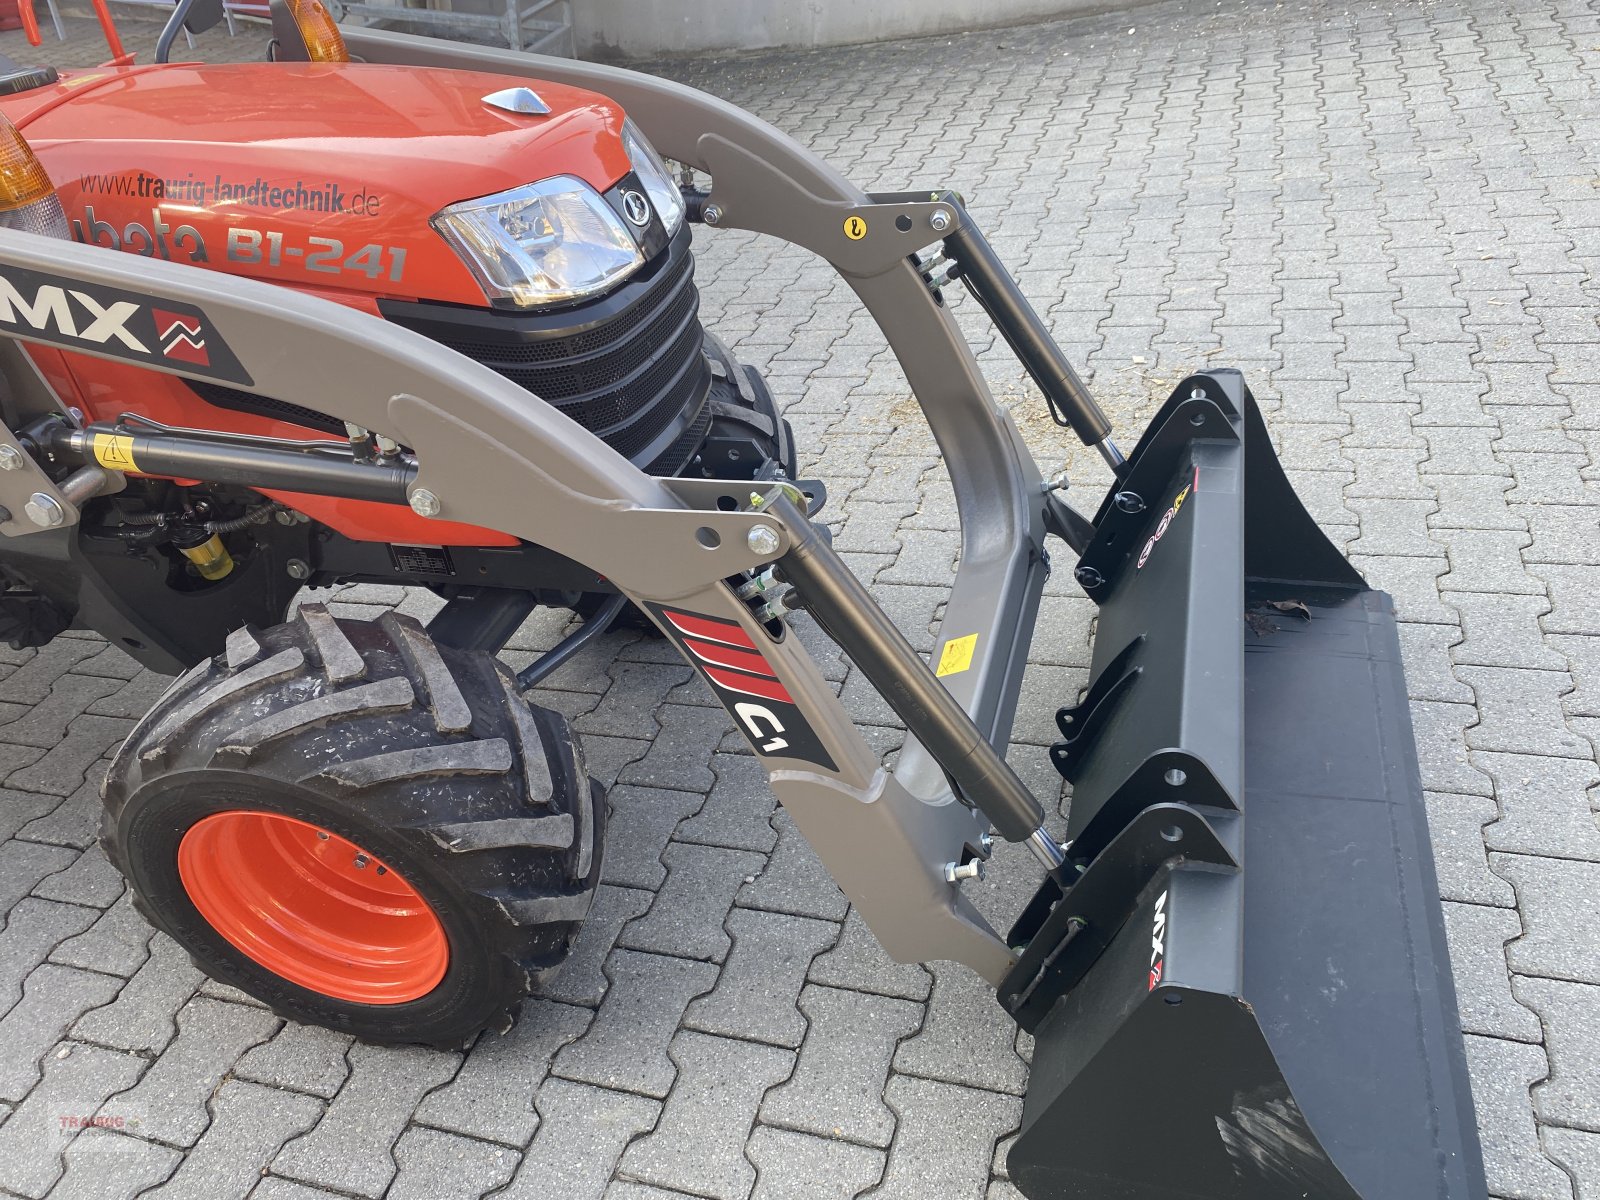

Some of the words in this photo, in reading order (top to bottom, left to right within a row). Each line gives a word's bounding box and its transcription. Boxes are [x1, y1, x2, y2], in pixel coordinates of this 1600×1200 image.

[80, 173, 380, 217] www.traurig-landtechnik.de
[227, 227, 407, 282] B1-241
[0, 274, 152, 354] MX
[734, 702, 789, 752] C1
[1150, 890, 1167, 967] MX
